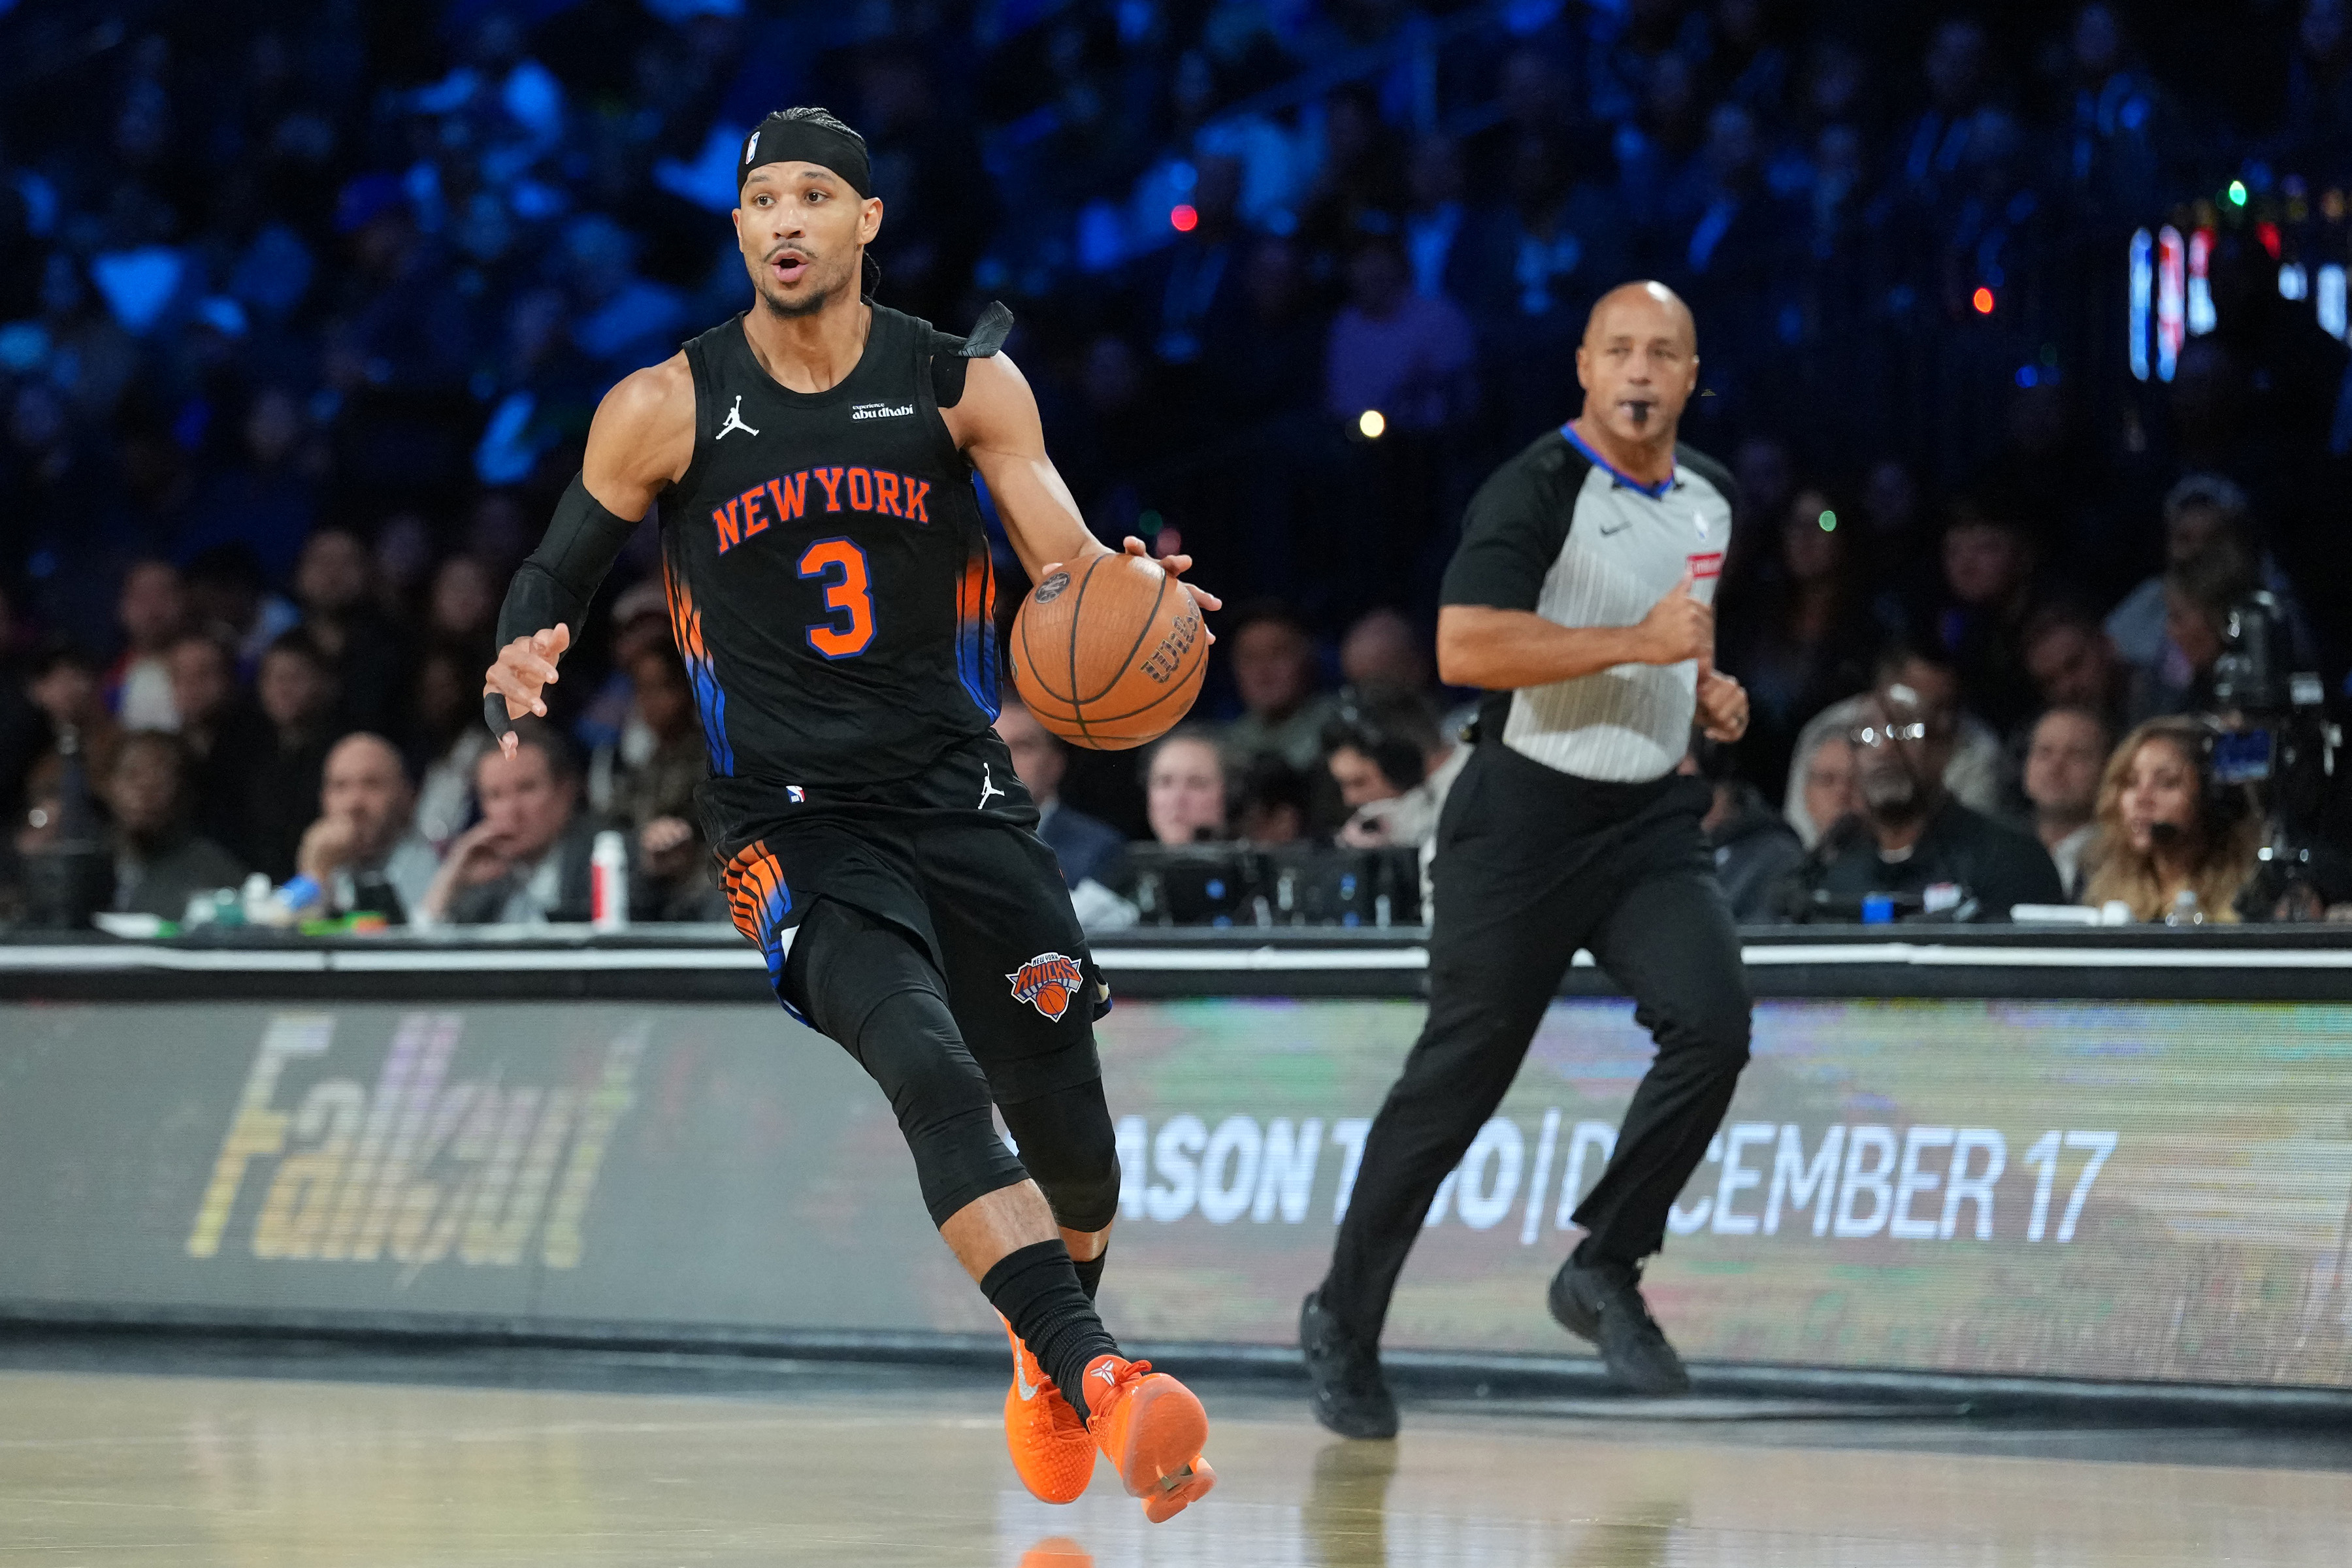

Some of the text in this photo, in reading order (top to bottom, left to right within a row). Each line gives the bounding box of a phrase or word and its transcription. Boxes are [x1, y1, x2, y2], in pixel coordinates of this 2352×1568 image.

[852, 404, 913, 419] abu dhabi
[711, 466, 931, 556] NEW YORK
[796, 535, 877, 661] 3
[1014, 957, 1081, 996] KNICKS
[1032, 956, 1045, 966] NEW
[1003, 1113, 1324, 1224] ASON
[1331, 1116, 1525, 1230] TO
[2023, 1130, 2118, 1243] 17
